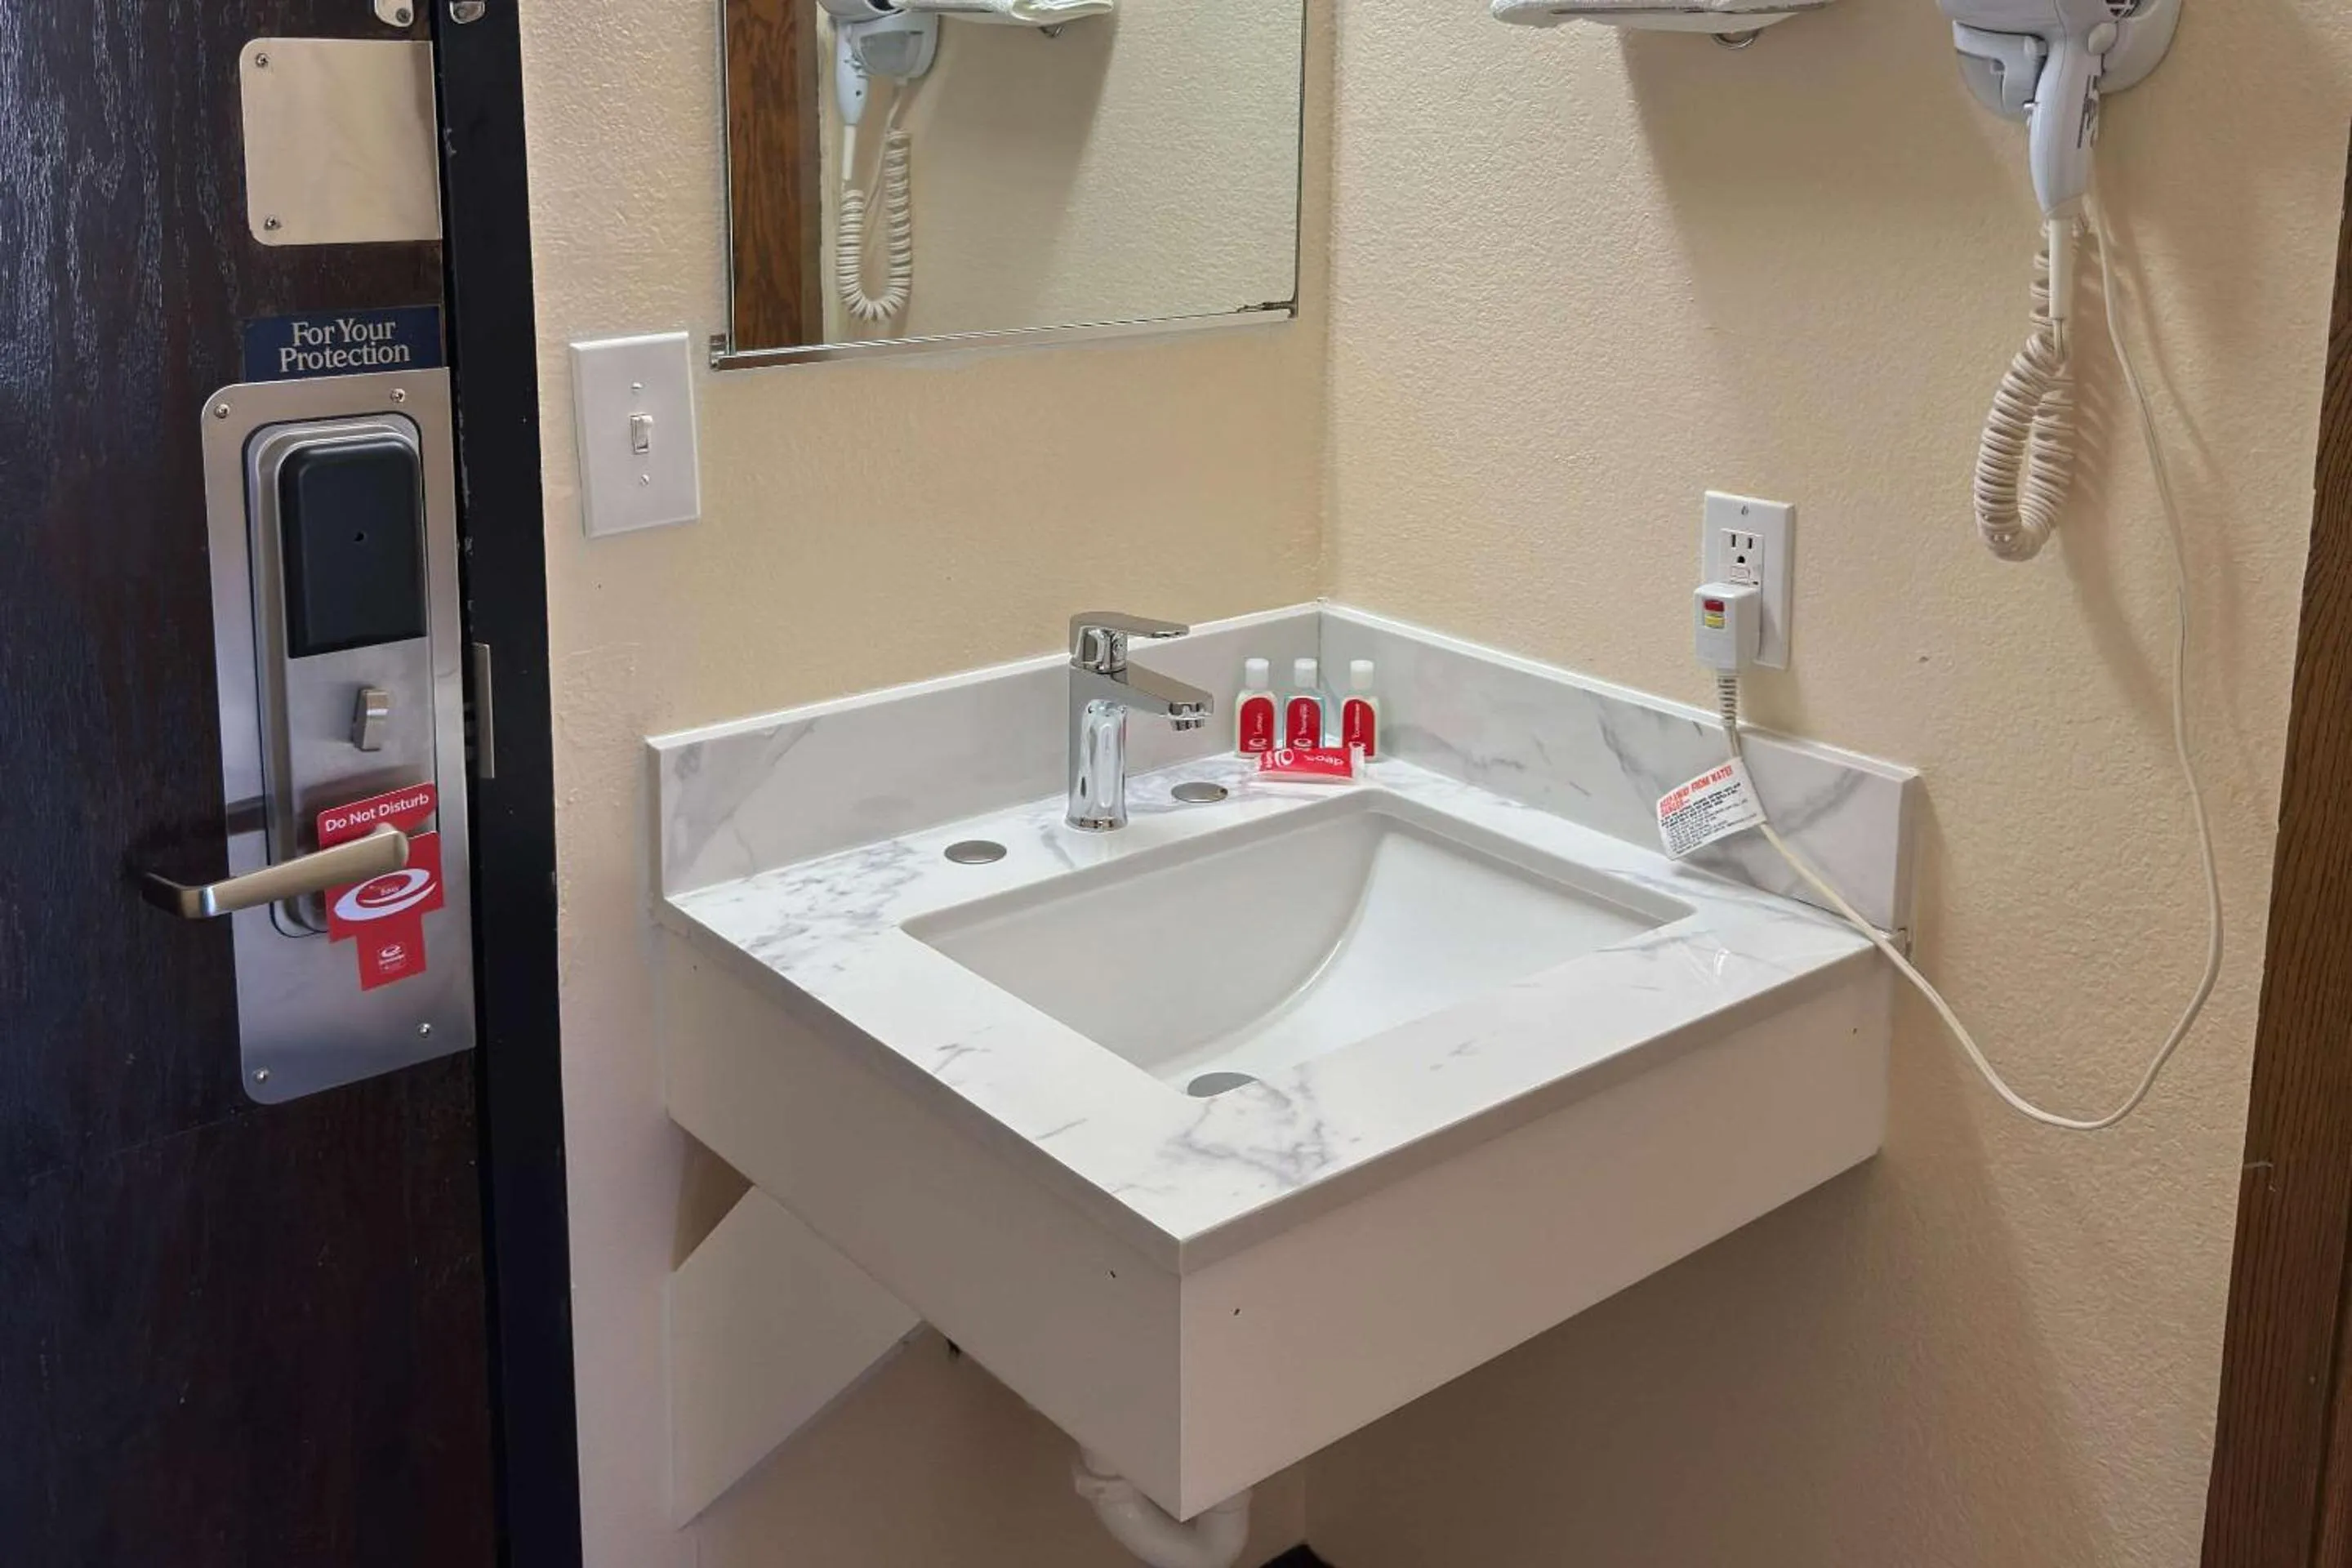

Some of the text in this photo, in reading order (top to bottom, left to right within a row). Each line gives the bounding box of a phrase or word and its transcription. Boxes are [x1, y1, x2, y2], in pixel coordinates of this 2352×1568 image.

[292, 318, 396, 347] For Your
[279, 341, 410, 372] Protection
[326, 794, 429, 832] Do Not Disturb
